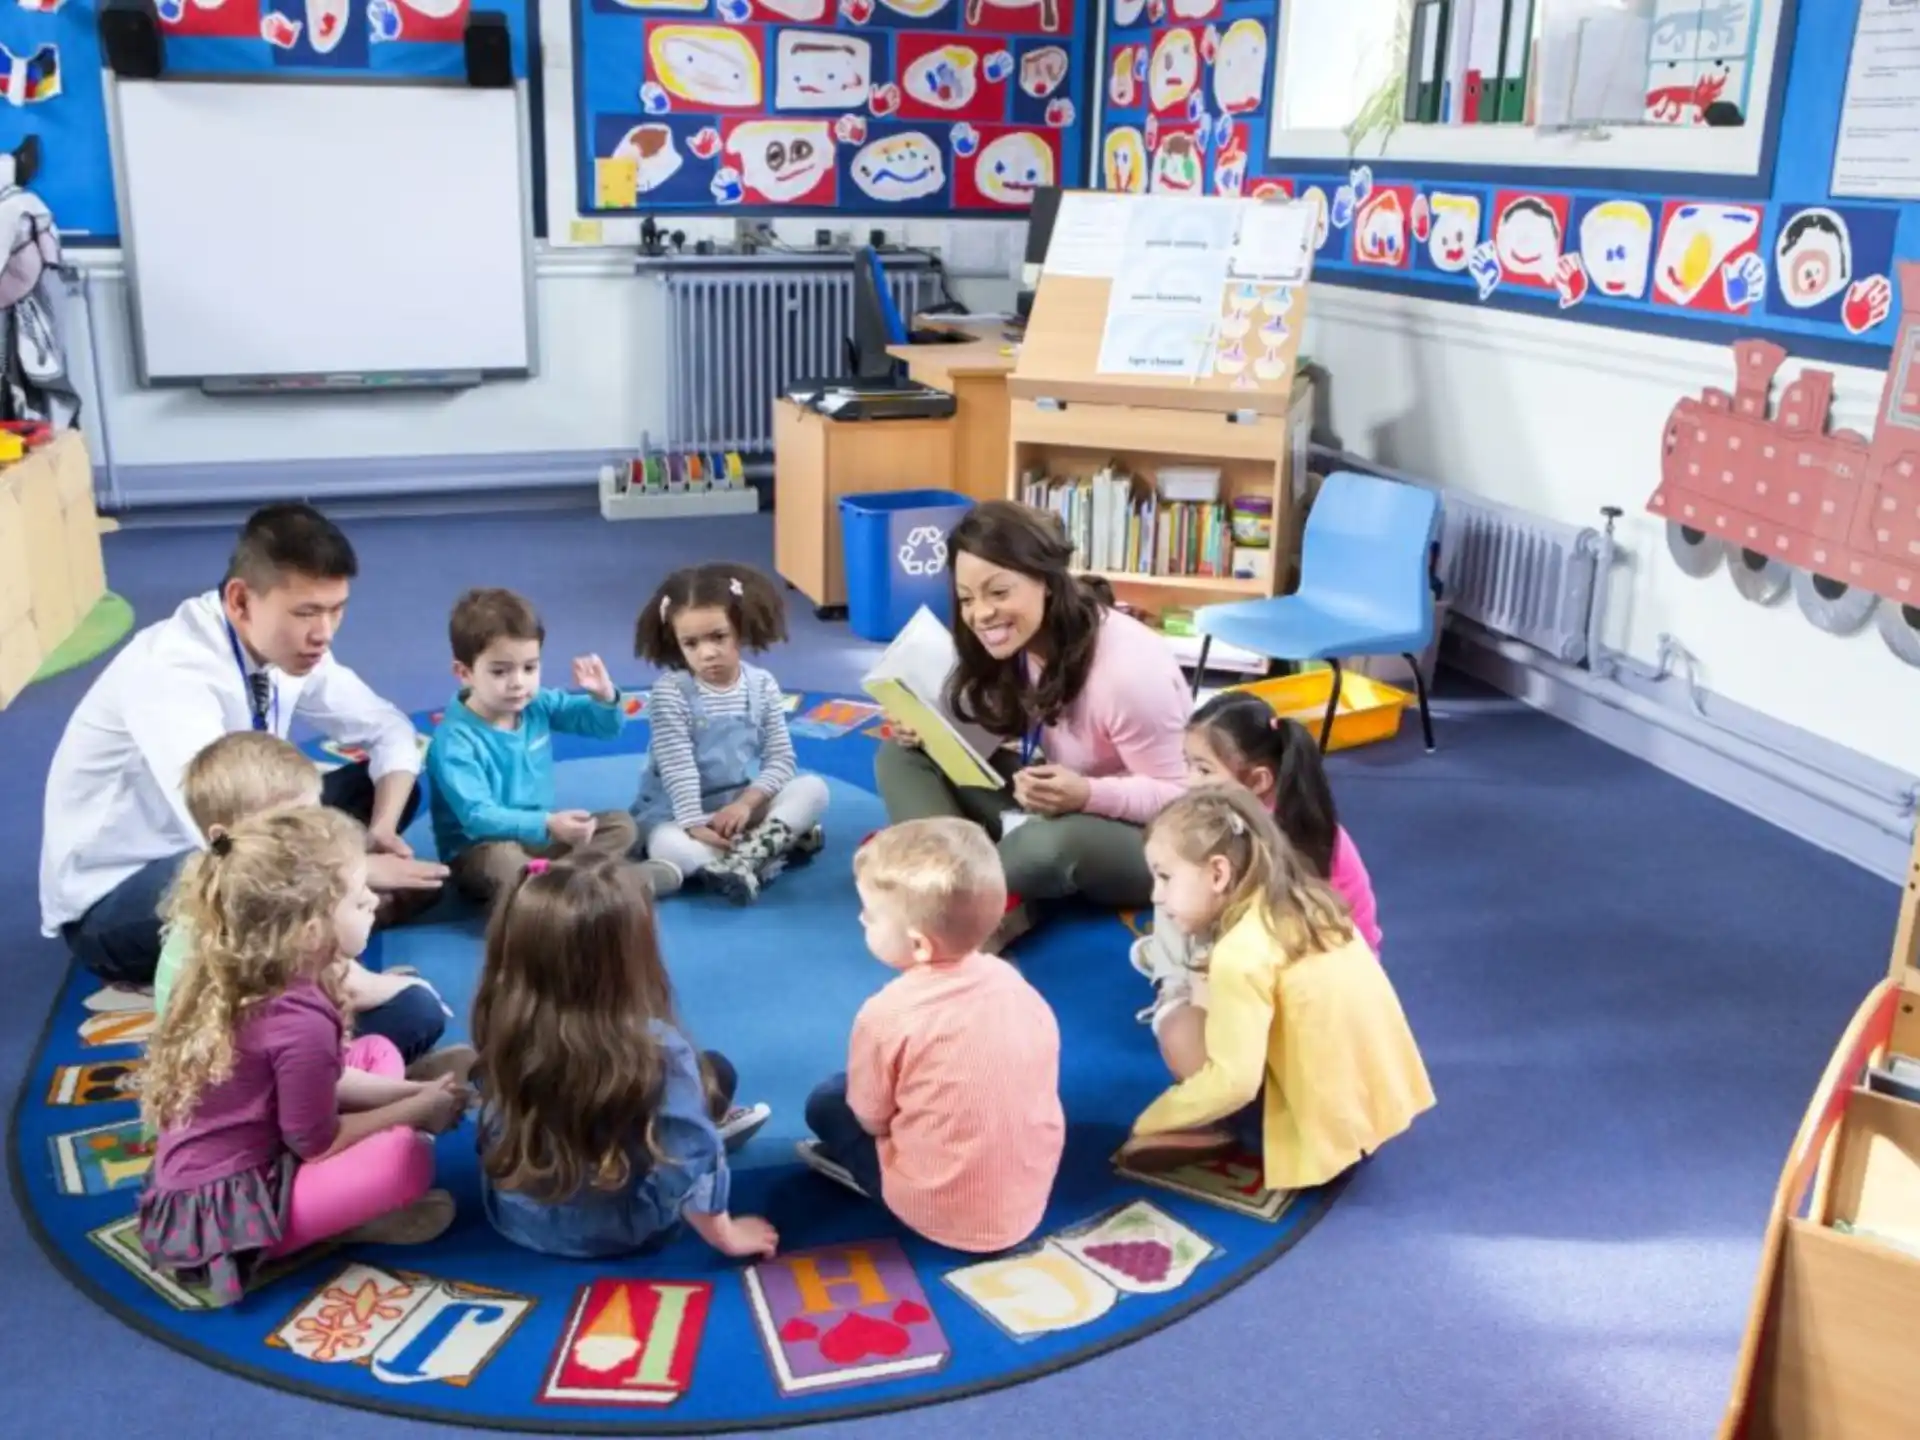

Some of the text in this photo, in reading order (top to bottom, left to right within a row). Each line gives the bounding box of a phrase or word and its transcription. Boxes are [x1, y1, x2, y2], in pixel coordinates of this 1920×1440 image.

[789, 1250, 890, 1314] H
[377, 1304, 504, 1377] J
[623, 1285, 702, 1387] I
